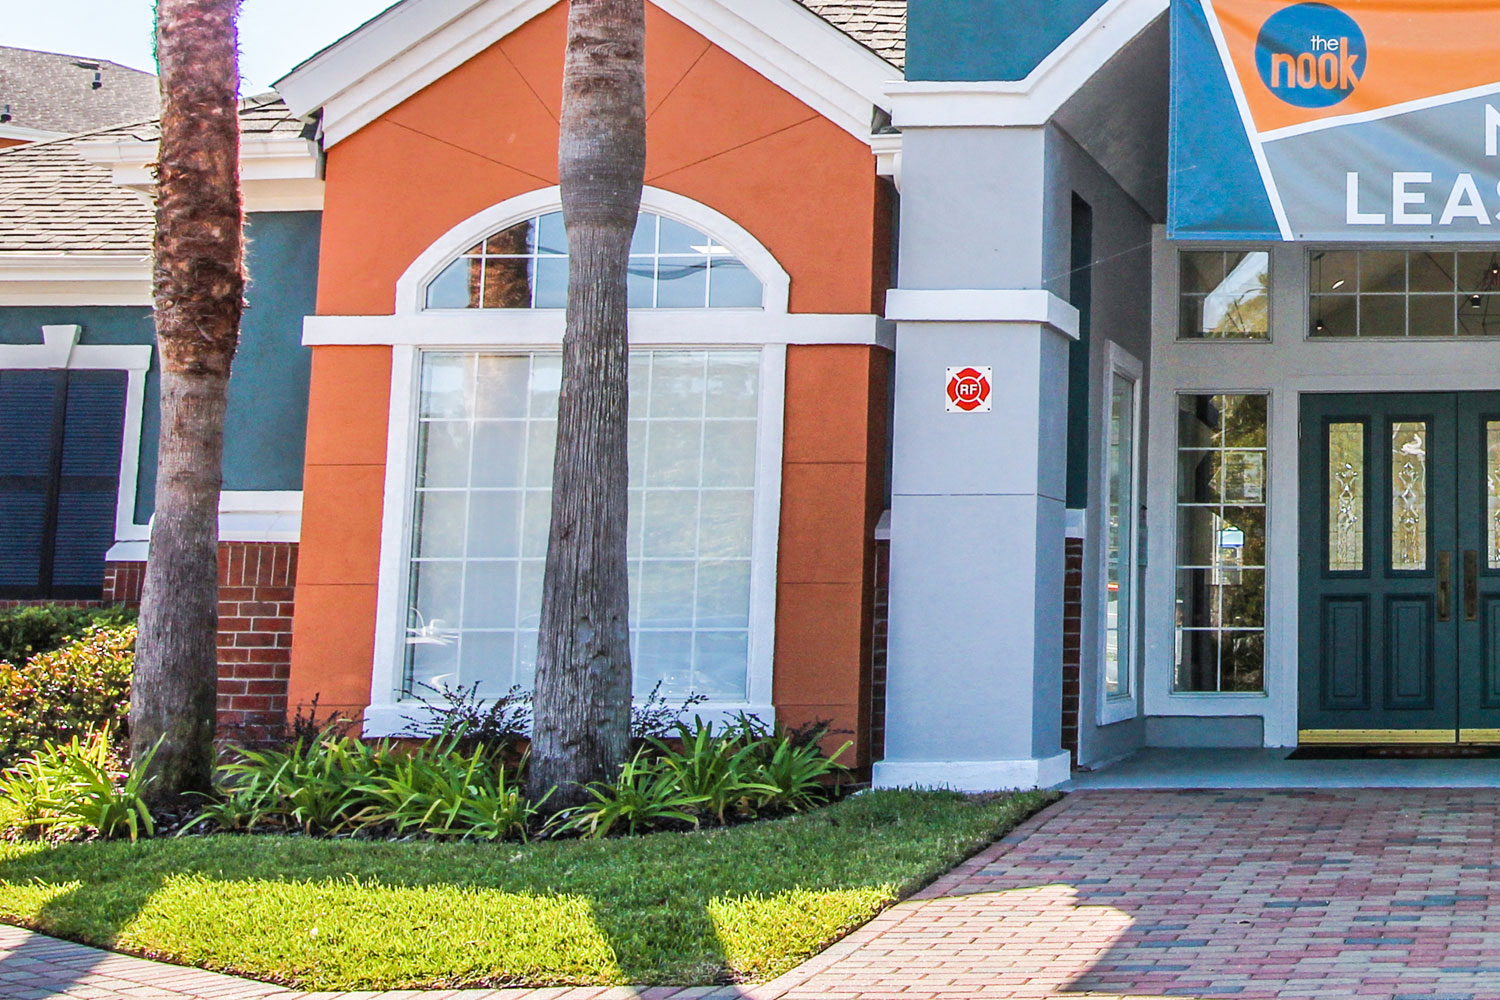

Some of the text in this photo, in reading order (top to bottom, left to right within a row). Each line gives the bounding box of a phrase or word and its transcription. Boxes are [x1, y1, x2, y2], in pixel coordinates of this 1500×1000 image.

[1310, 35, 1339, 51] the
[1271, 36, 1360, 90] nook
[960, 384, 978, 395] RF
